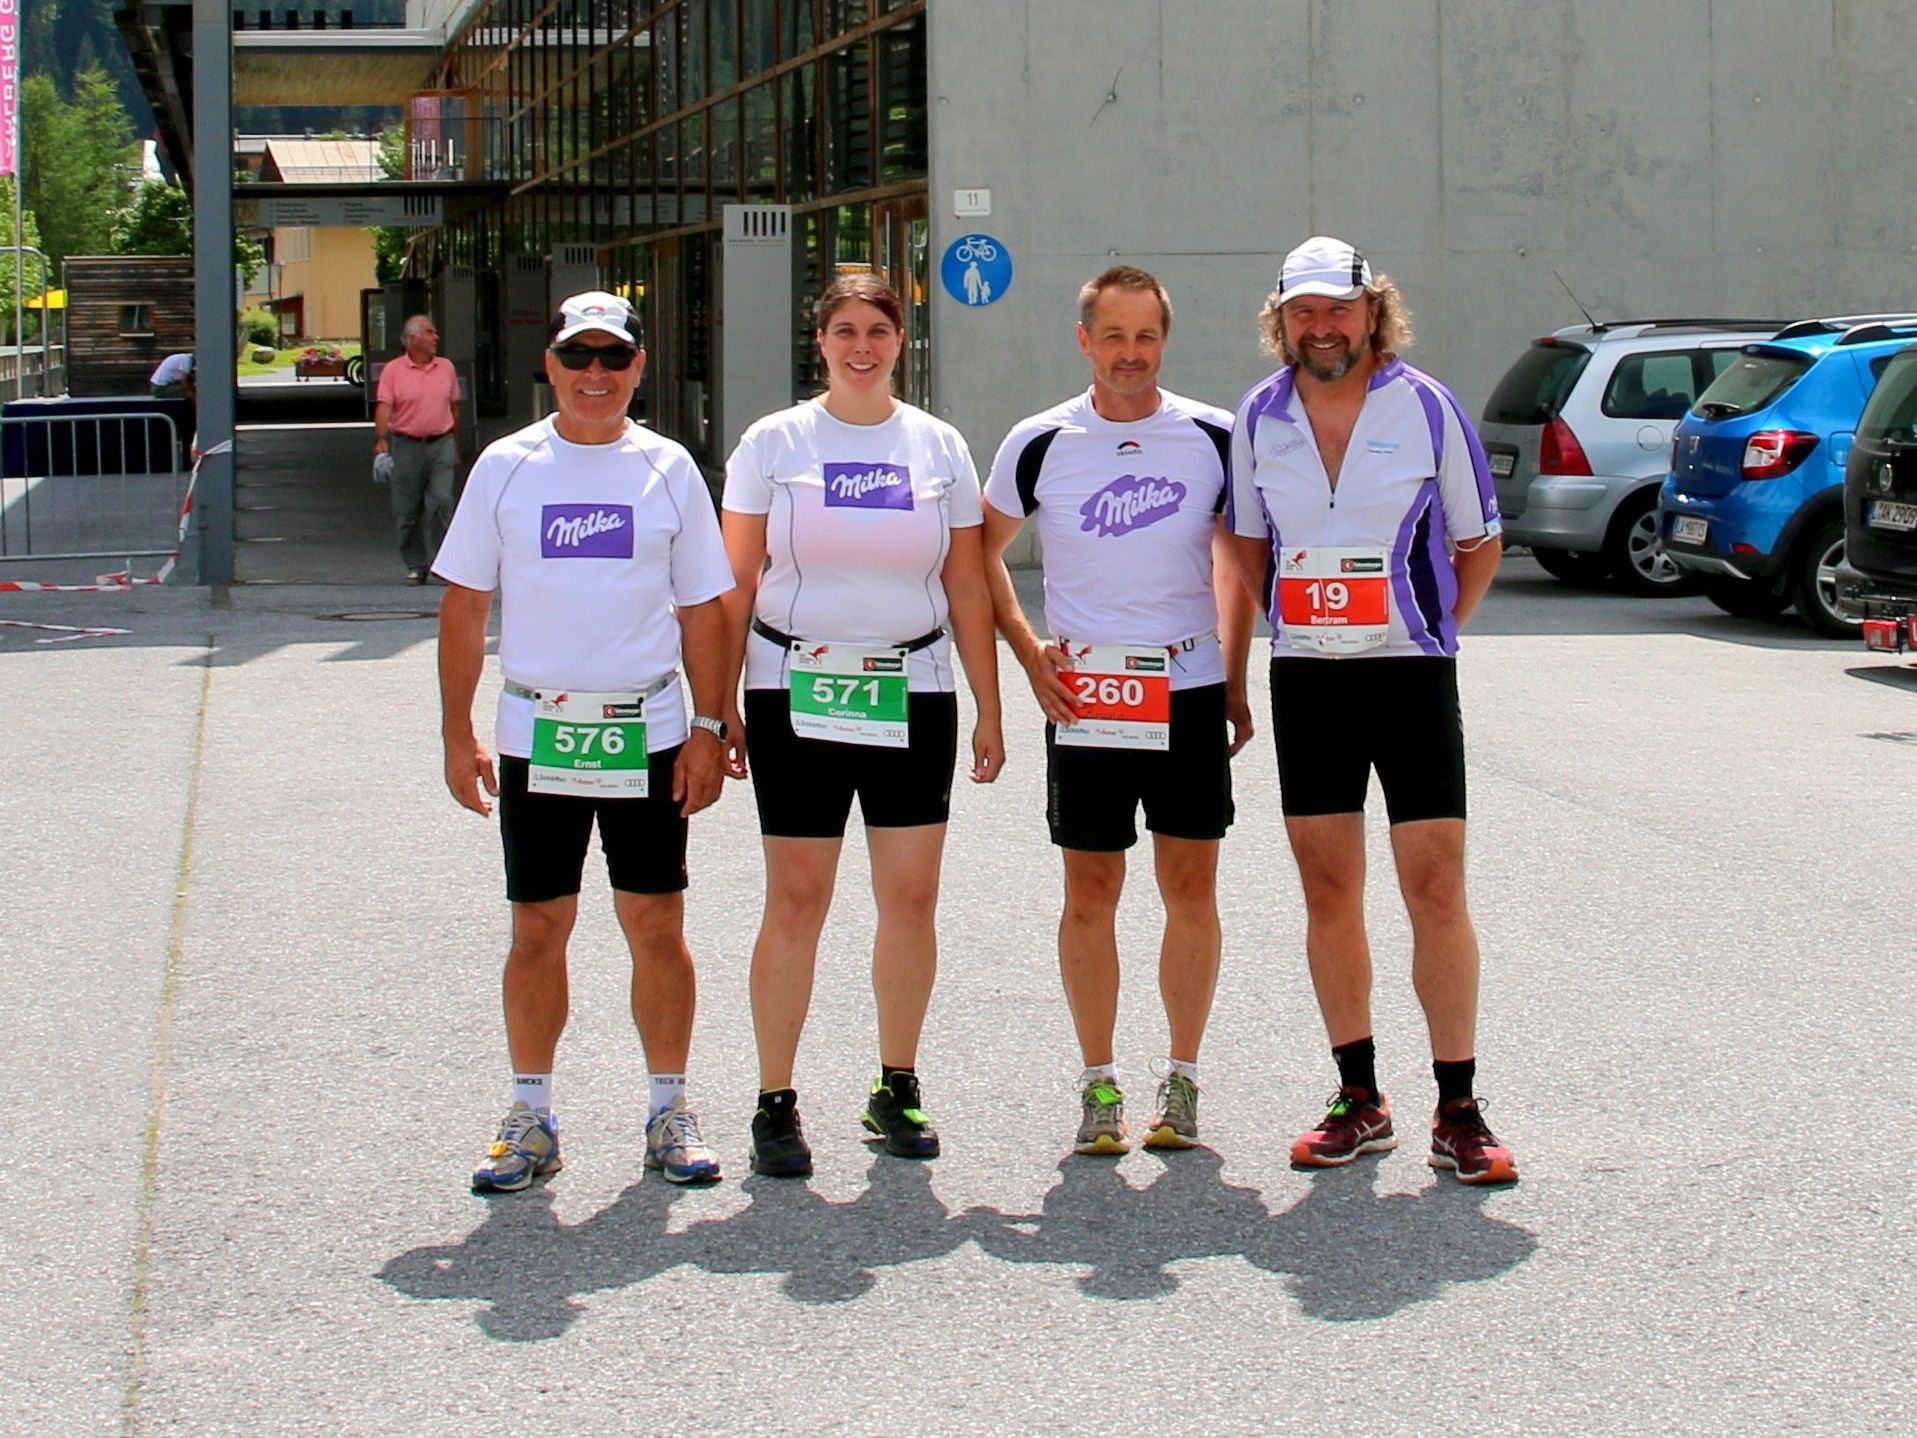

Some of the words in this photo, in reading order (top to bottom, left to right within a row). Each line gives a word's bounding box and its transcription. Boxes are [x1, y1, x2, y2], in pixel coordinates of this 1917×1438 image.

[966, 192, 978, 206] 11
[831, 468, 903, 499] Milka
[1094, 482, 1178, 526] Milka
[546, 509, 625, 548] Milka
[1306, 582, 1349, 610] 19
[812, 678, 879, 706] 571
[1075, 677, 1144, 706] 260
[828, 708, 867, 718] Corinna
[554, 726, 625, 754] 576
[574, 759, 602, 768] Ernst
